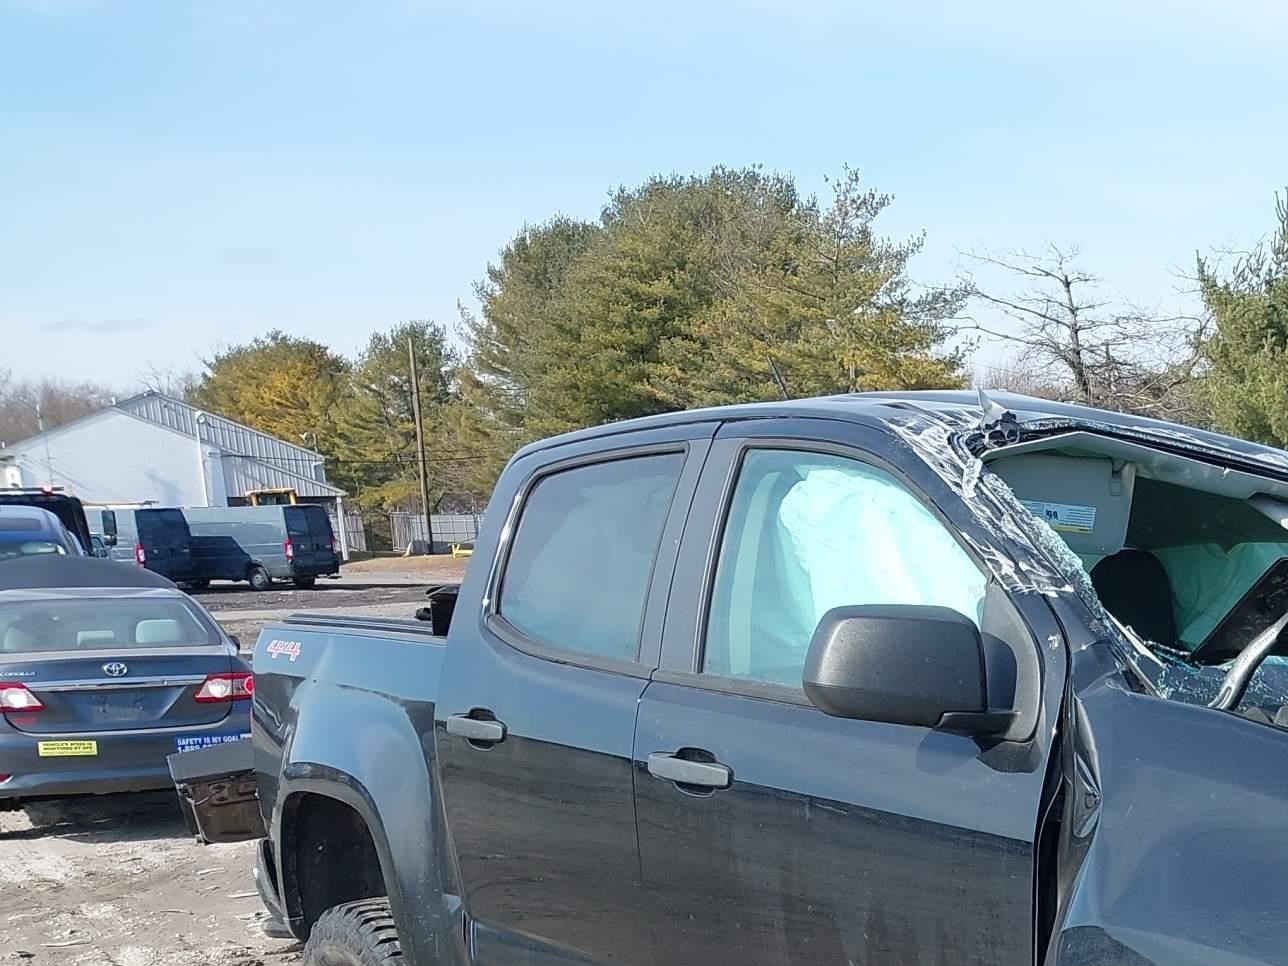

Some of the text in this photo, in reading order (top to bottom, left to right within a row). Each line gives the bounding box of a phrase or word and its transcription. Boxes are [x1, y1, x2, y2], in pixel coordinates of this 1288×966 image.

[177, 738, 202, 746] SAFETY
[203, 736, 211, 745] IS
[211, 735, 222, 744] MY
[222, 734, 239, 743] GOAL
